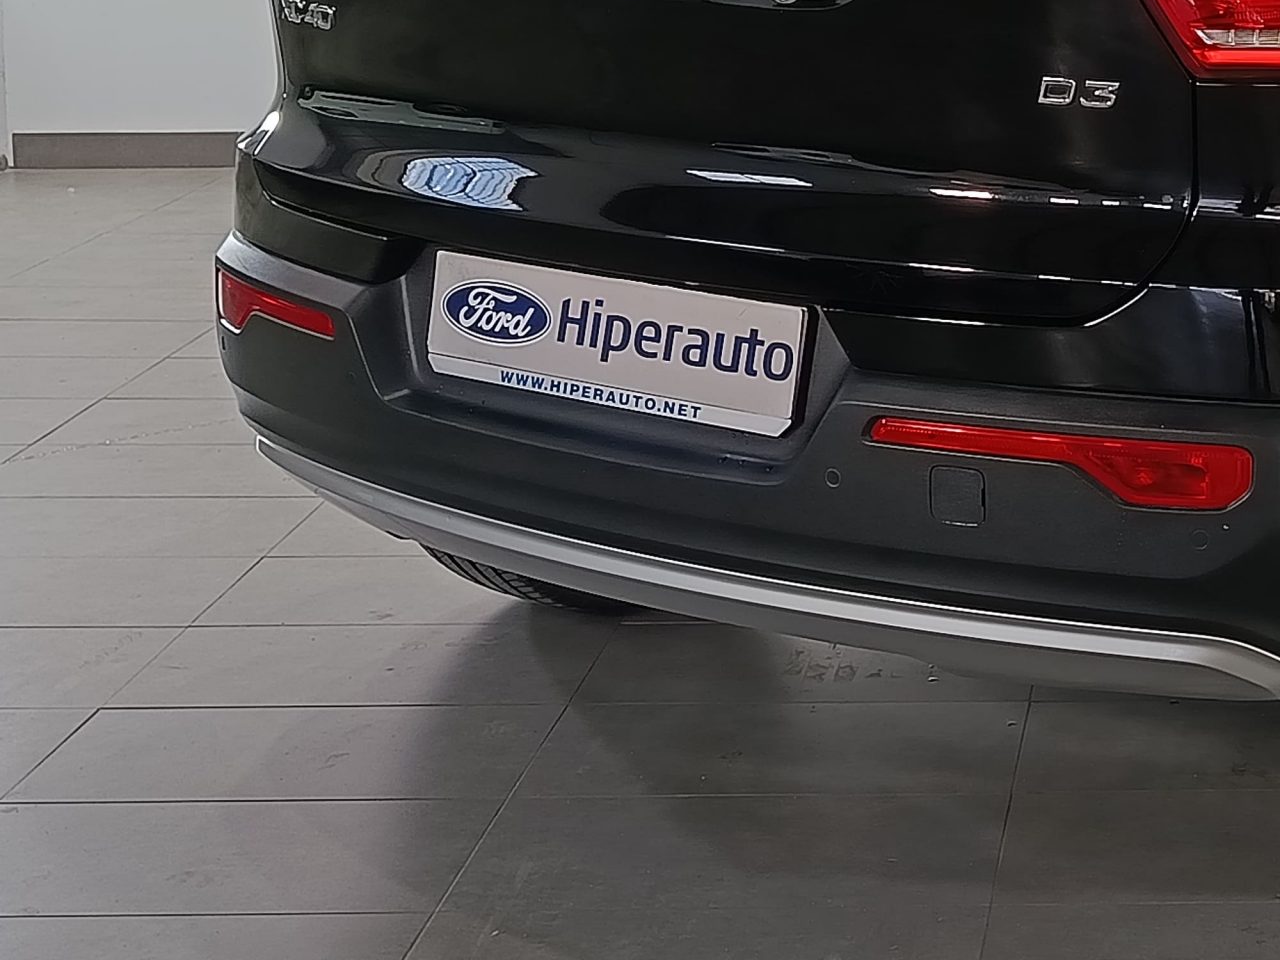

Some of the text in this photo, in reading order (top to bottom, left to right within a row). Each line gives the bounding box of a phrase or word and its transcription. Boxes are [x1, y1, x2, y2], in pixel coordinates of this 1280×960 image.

[1038, 76, 1120, 108] D3
[457, 286, 535, 339] Ford
[556, 298, 795, 382] Hiperauto
[500, 369, 703, 420] WWW.HIPERAUTO.NET
